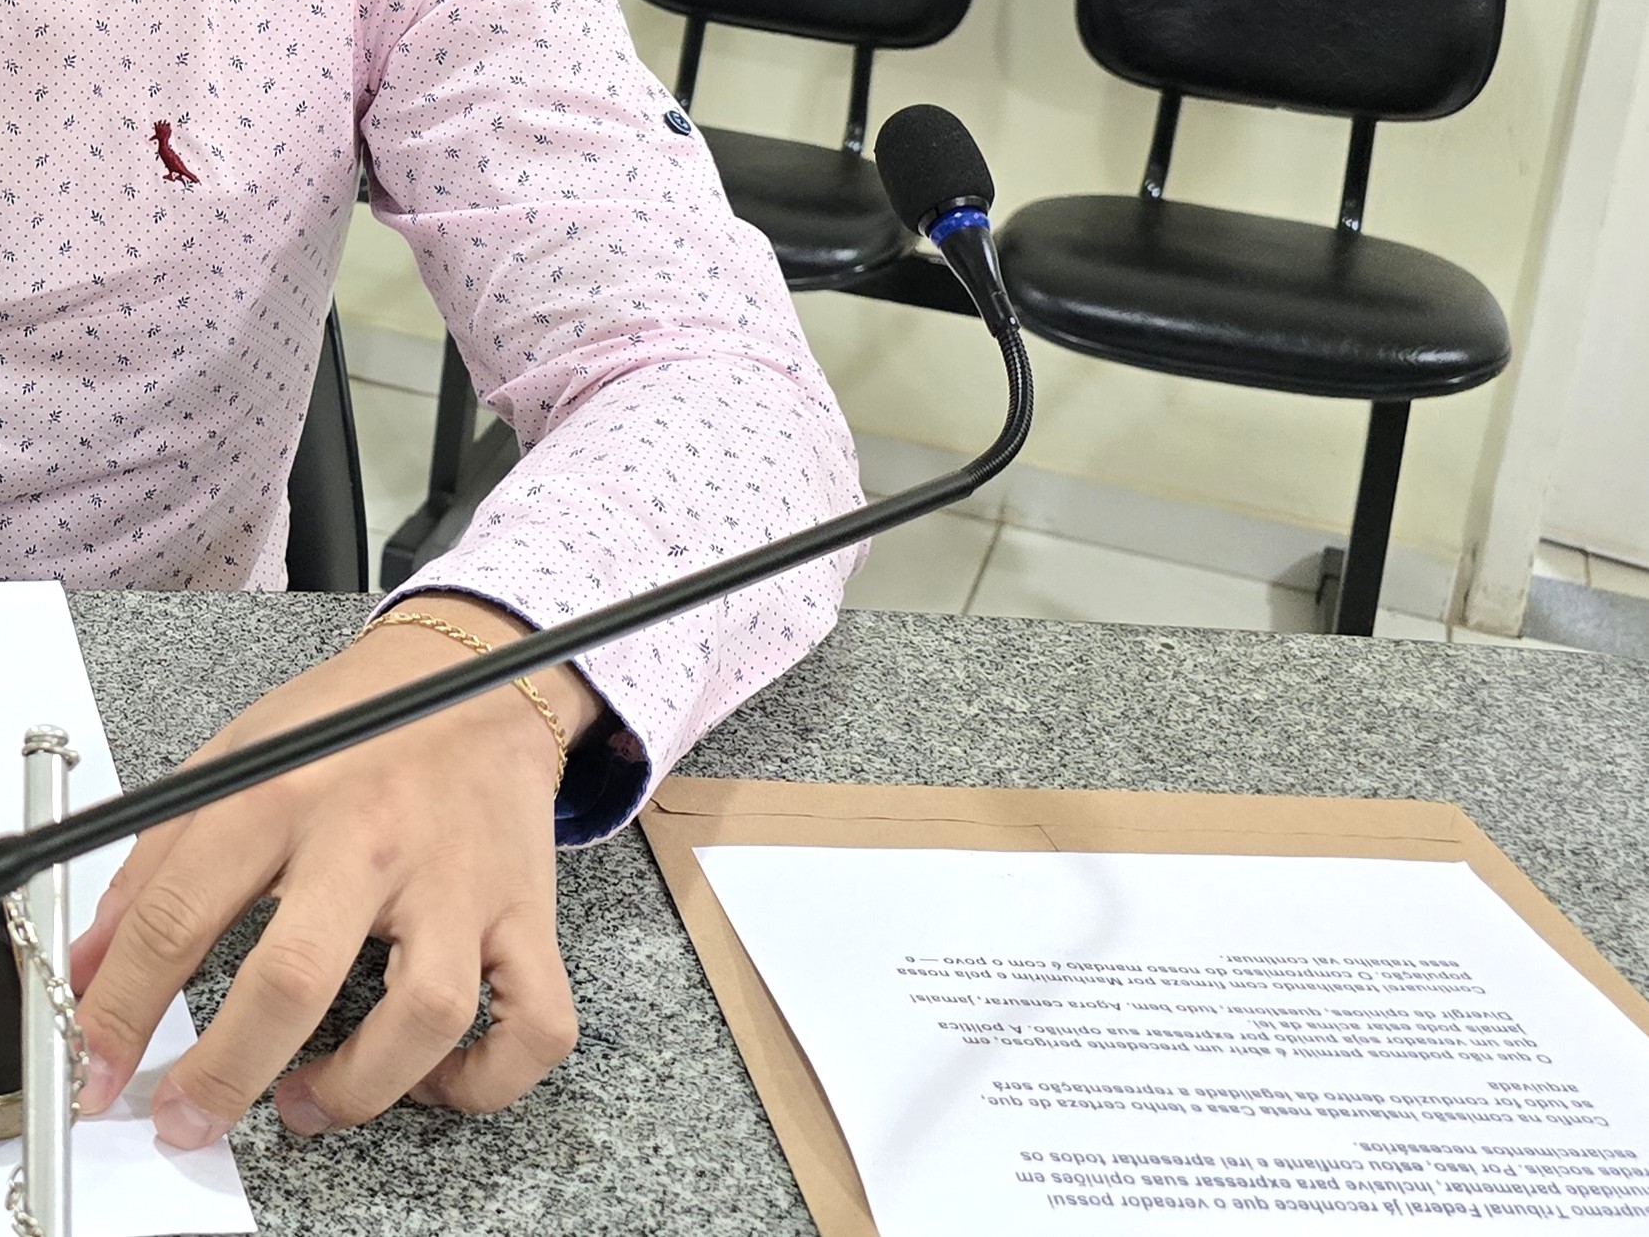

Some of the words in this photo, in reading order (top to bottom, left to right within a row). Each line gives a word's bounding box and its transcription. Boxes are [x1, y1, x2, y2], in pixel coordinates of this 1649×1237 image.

[943, 956, 987, 965] povo
[1007, 959, 1046, 968] com
[1219, 955, 1309, 965] continuar.
[1312, 957, 1340, 966] vai
[1343, 958, 1417, 968] trabalho
[1419, 960, 1460, 968] esse
[896, 968, 950, 977] nossa
[1066, 962, 1143, 973] mandato
[1146, 965, 1201, 974] nosso
[1205, 967, 1228, 977] do
[1232, 968, 1353, 978] compromisso
[954, 969, 992, 980] pela
[1011, 972, 1124, 986] Manhumirim
[1357, 971, 1373, 981] O
[1375, 970, 1473, 981] população.
[1127, 976, 1157, 985] por
[1160, 979, 1226, 990] firmeza
[1229, 981, 1268, 989] com
[1272, 982, 1380, 993] trabalhando
[1382, 985, 1486, 994] Continuarei
[909, 994, 975, 1006] jamais!
[977, 996, 1063, 1008] censurar,
[1067, 1000, 1121, 1011] Agora
[1126, 1002, 1173, 1013] bem.
[1175, 1004, 1218, 1014] tudo
[1219, 1005, 1322, 1017] questionar,
[1413, 1010, 1436, 1020] de
[1441, 1009, 1514, 1021] Divergir
[1008, 1024, 1022, 1035] A
[1027, 1025, 1102, 1036] opinião.
[1248, 1020, 1277, 1030] lei.
[1278, 1021, 1302, 1031] da
[1306, 1022, 1361, 1032] acima
[1367, 1023, 1412, 1032] estar
[1415, 1023, 1462, 1033] pode
[1465, 1023, 1527, 1035] jamais
[1106, 1028, 1140, 1036] sua
[1146, 1029, 1235, 1040] expressar
[1240, 1031, 1270, 1041] por
[962, 1036, 991, 1045] em
[993, 1036, 1082, 1049] perigoso,
[1274, 1033, 1339, 1044] punido
[1342, 1034, 1382, 1045] seja
[1386, 1036, 1467, 1047] vereador
[1469, 1039, 1500, 1047] um
[1503, 1037, 1538, 1048] que
[1087, 1041, 1190, 1052] precedente
[1193, 1044, 1224, 1053] um
[1229, 1046, 1271, 1056] abrir
[1292, 1048, 1364, 1058] permitir
[1367, 1050, 1455, 1061] podemos
[1458, 1052, 1494, 1062] não
[1497, 1051, 1532, 1062] que
[1536, 1054, 1552, 1064] O
[992, 1081, 1034, 1092] será
[1038, 1081, 1174, 1096] representação
[1177, 1087, 1190, 1096] a
[1487, 1082, 1579, 1093] arquivada
[981, 1094, 1023, 1107] que,
[1195, 1088, 1293, 1102] legalidade
[1294, 1092, 1319, 1103] da
[1323, 1092, 1385, 1105] dentro
[1028, 1098, 1052, 1110] de
[1056, 1099, 1126, 1111] certeza
[1389, 1095, 1489, 1107] conduzido
[1494, 1098, 1522, 1109] for
[1524, 1099, 1569, 1110] tudo
[1570, 1100, 1594, 1108] se
[1131, 1101, 1187, 1114] tenho
[1190, 1104, 1202, 1112] e
[1206, 1104, 1256, 1117] Casa
[1259, 1106, 1312, 1117] nesta
[1315, 1108, 1419, 1122] instaurada
[1421, 1111, 1514, 1123] comissão
[1517, 1114, 1542, 1123] na
[1545, 1115, 1609, 1127] Confio
[1353, 1142, 1478, 1156] necessários.
[1481, 1146, 1637, 1160] esclarecimentos
[1020, 1151, 1044, 1162] os
[1049, 1152, 1107, 1166] todos
[1112, 1153, 1216, 1167] apresentar
[1220, 1157, 1254, 1170] irei
[1256, 1158, 1269, 1168] e
[1273, 1158, 1364, 1173] confiante
[1368, 1160, 1424, 1174] estou
[1426, 1160, 1478, 1176] isso,
[1481, 1163, 1518, 1177] Por
[1518, 1164, 1595, 1177] sociais.
[1015, 1172, 1045, 1183] em
[1050, 1171, 1136, 1188] opiniões
[1141, 1175, 1189, 1186] suas
[1195, 1174, 1292, 1189] expressar
[1296, 1176, 1341, 1190] para
[1345, 1180, 1435, 1195] inclusive
[1436, 1180, 1562, 1197] parlamentar,
[1047, 1192, 1115, 1209] possui
[1121, 1196, 1209, 1211] vereador
[1213, 1198, 1226, 1209] o
[1232, 1195, 1270, 1210] que
[1274, 1199, 1379, 1214] reconhece
[1382, 1198, 1403, 1216] já
[1405, 1202, 1482, 1218] Federal
[1483, 1203, 1570, 1219] Tribunal
